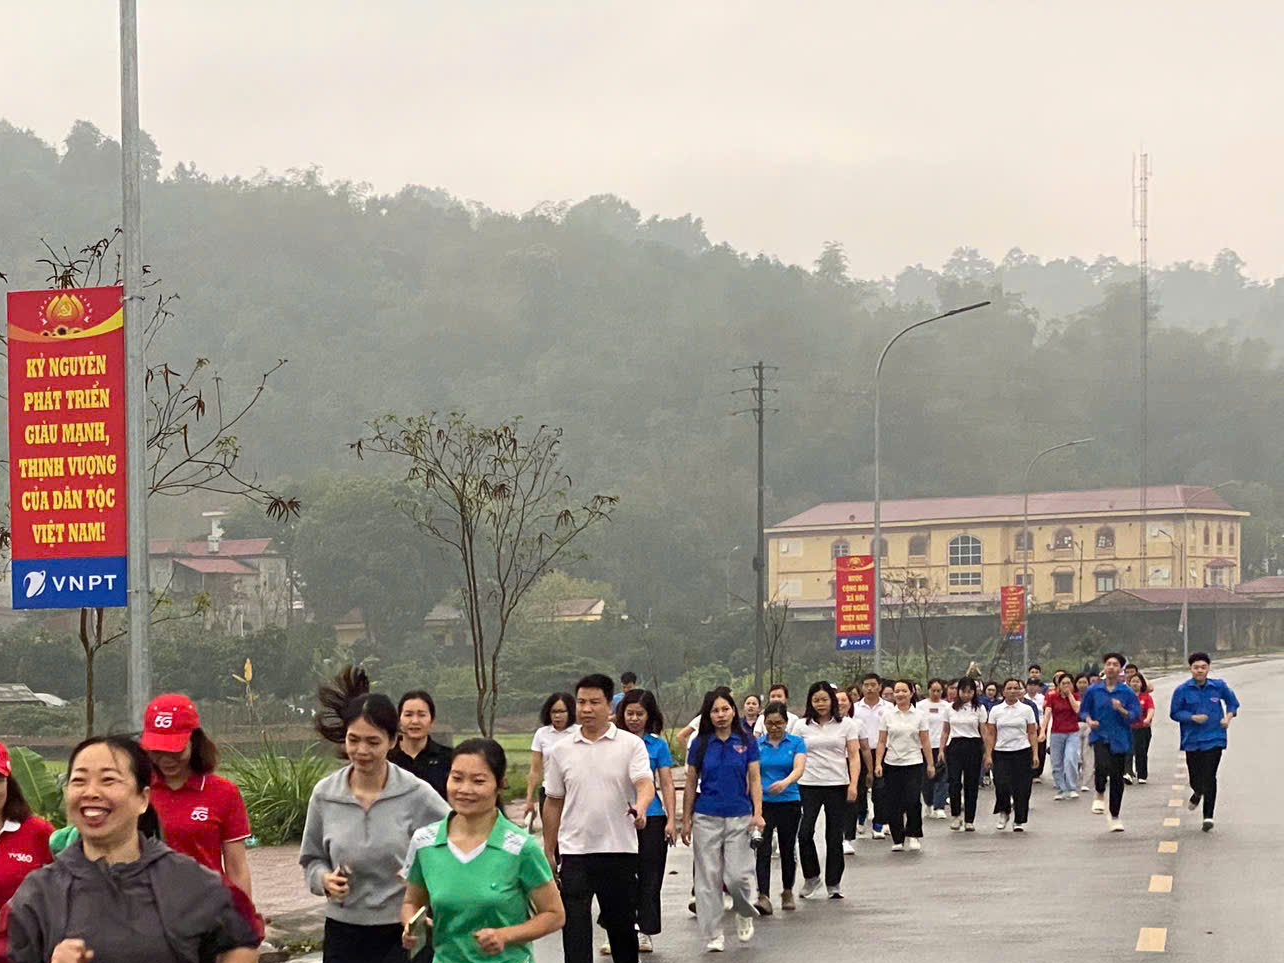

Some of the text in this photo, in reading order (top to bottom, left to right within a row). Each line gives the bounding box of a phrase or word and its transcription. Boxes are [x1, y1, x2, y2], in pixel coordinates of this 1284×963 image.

[49, 351, 106, 377] NGUYÊN
[24, 380, 110, 412] PHÁT TRIỂN
[24, 420, 110, 447] GIÀU MẠNH,
[19, 457, 64, 482] THỊNH
[21, 484, 115, 513] CỦA DÂN TỘC
[32, 519, 106, 548] VIỆT NAM!
[52, 574, 117, 592] VNPT
[155, 715, 172, 728] 5G
[190, 810, 208, 821] 5G
